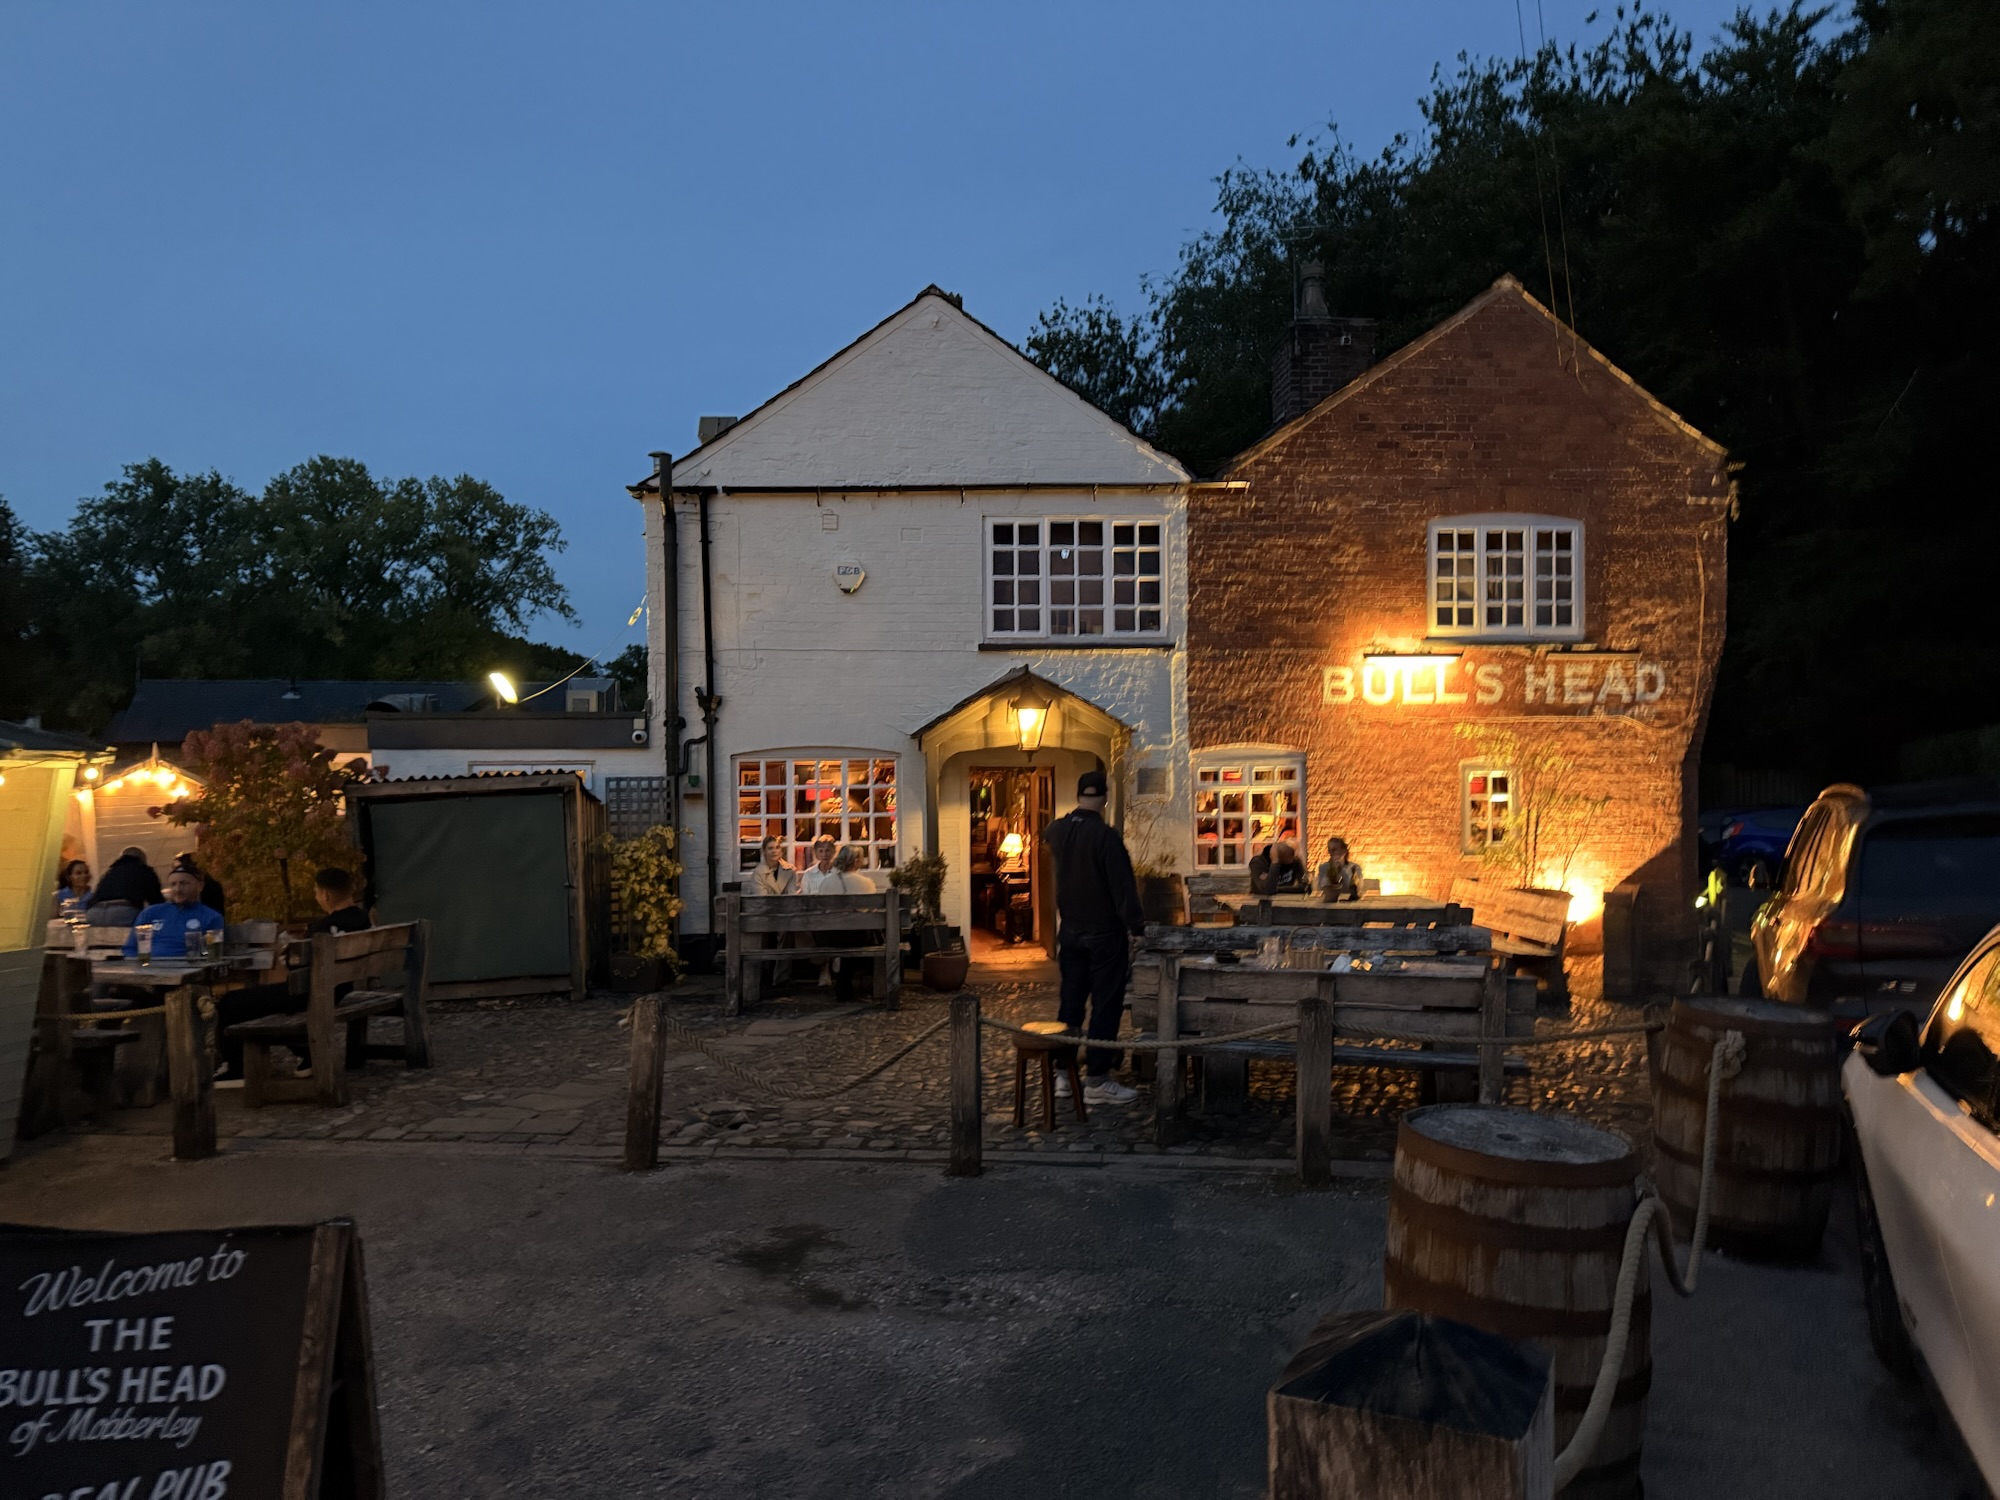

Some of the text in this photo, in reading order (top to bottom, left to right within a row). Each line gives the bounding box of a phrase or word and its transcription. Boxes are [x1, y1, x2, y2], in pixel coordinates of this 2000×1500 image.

[1323, 660, 1666, 706] BULL'S HEAD
[19, 1243, 248, 1317] Welcome to
[84, 1316, 175, 1352] THE
[0, 1364, 227, 1407] BULL'S HEAD
[8, 1408, 60, 1457] of
[150, 1459, 233, 1500] PUB
